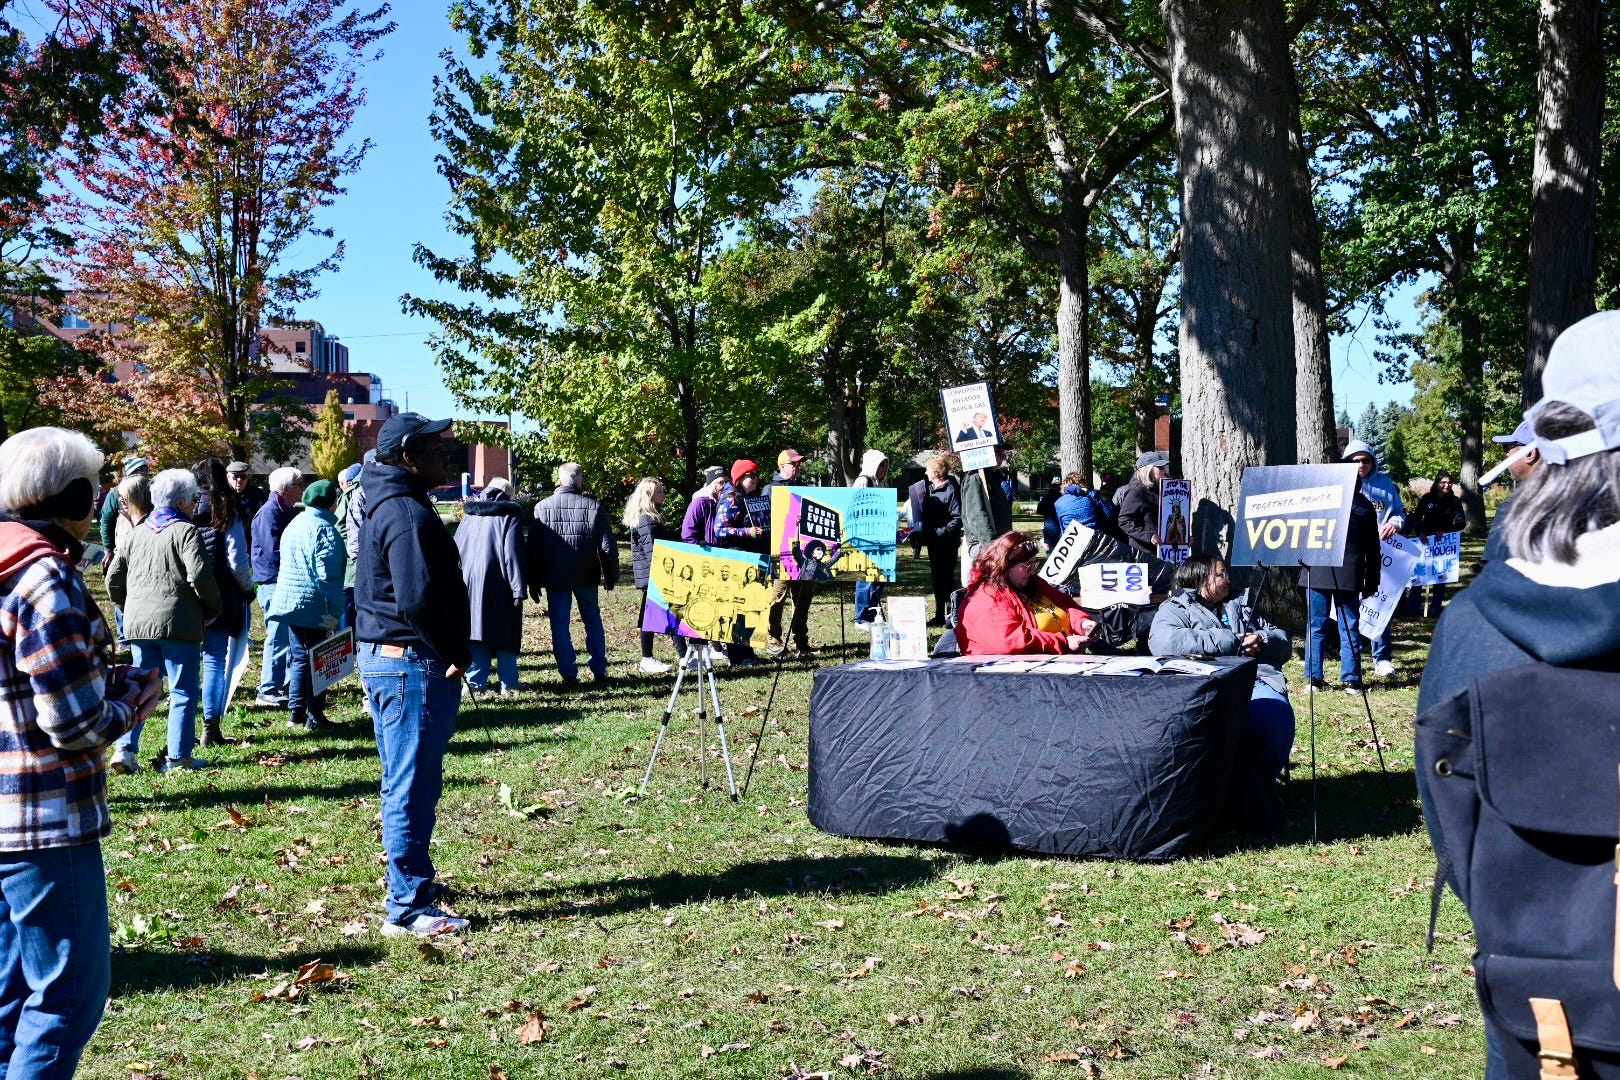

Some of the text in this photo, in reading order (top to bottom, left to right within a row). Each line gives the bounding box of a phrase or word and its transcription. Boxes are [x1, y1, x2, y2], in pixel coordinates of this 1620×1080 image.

[966, 449, 988, 458] VOTE
[967, 459, 991, 469] BLUE
[1165, 481, 1188, 490] STOP THE
[1163, 489, 1190, 499] INSANITY
[748, 501, 770, 513] RESIST
[807, 504, 836, 521] COUNT
[807, 512, 836, 529] EVERY
[806, 521, 836, 539] VOTE
[1246, 518, 1337, 550] VOTE!
[1386, 537, 1403, 550] ote
[1424, 544, 1457, 558] ENOUGH
